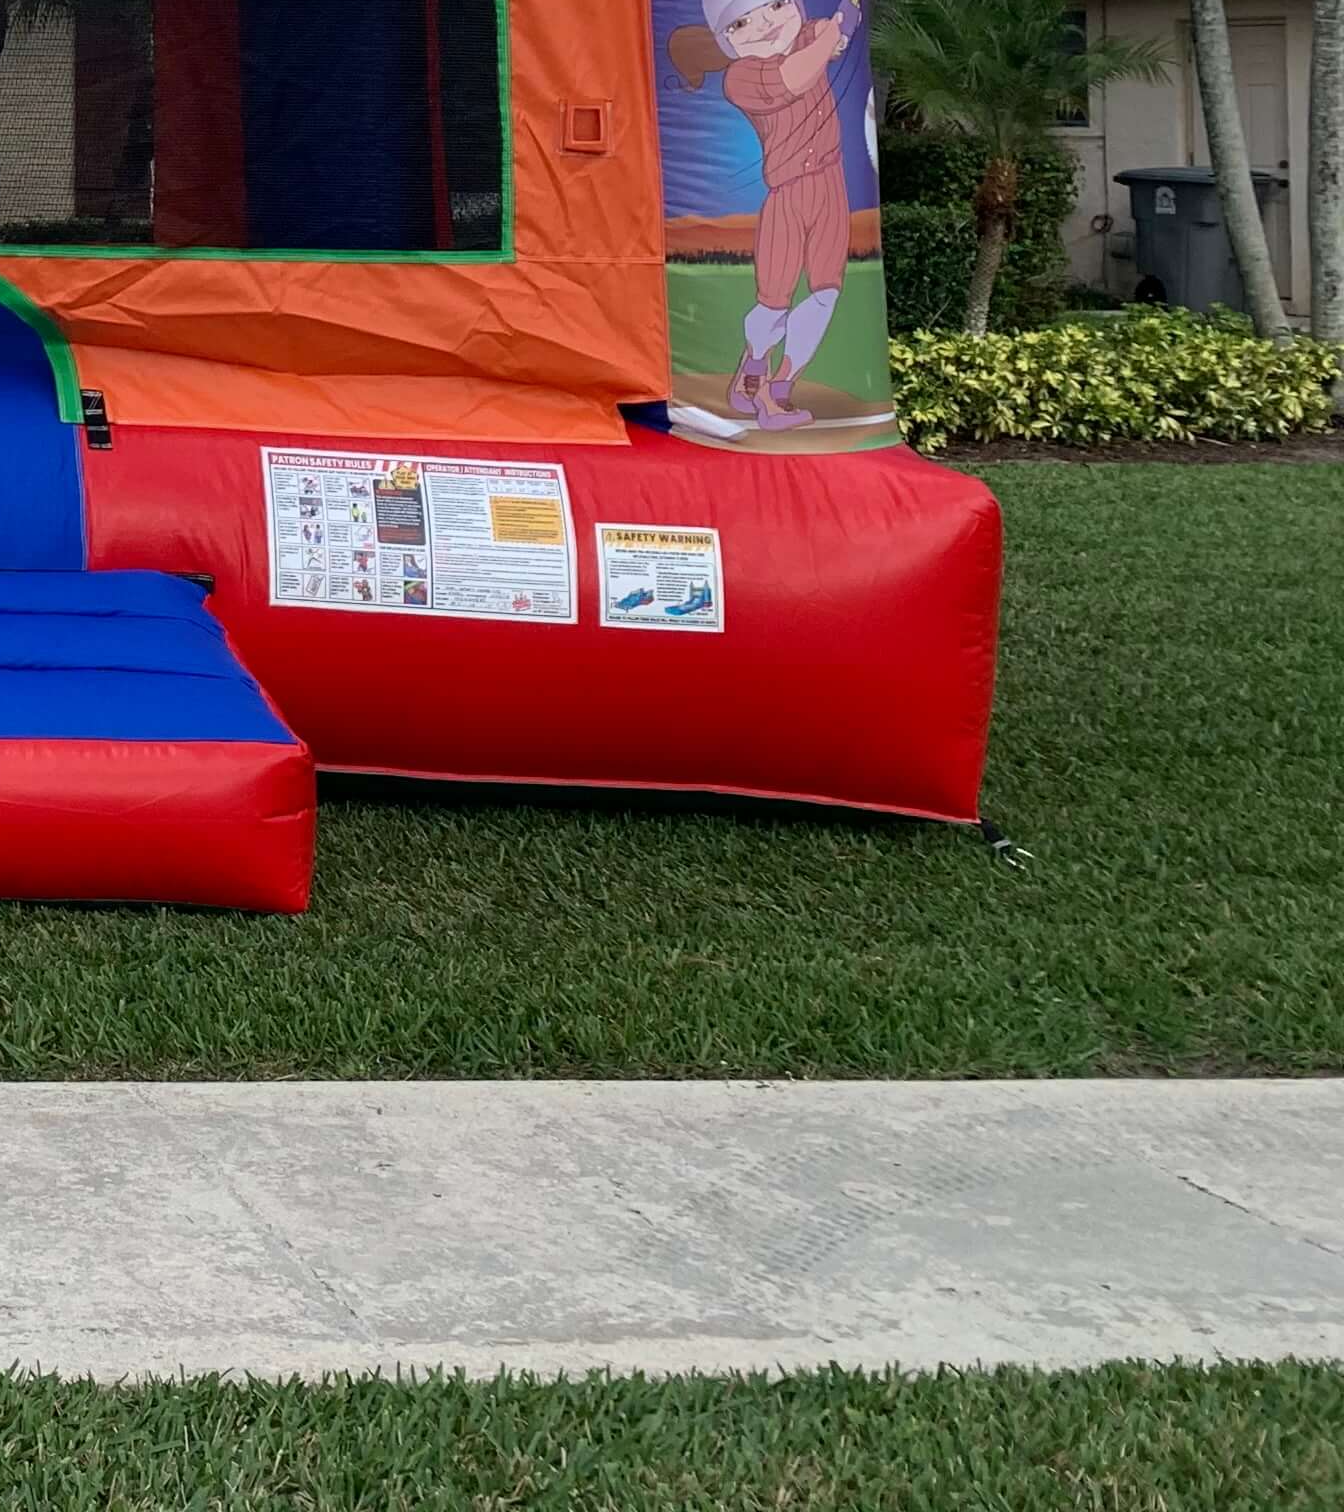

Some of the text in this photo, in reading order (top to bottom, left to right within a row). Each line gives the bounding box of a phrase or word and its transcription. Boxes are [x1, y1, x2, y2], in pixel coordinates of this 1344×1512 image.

[271, 455, 373, 470] PATRON SAFETY RULES
[616, 532, 712, 545] SAFETY WARNING
